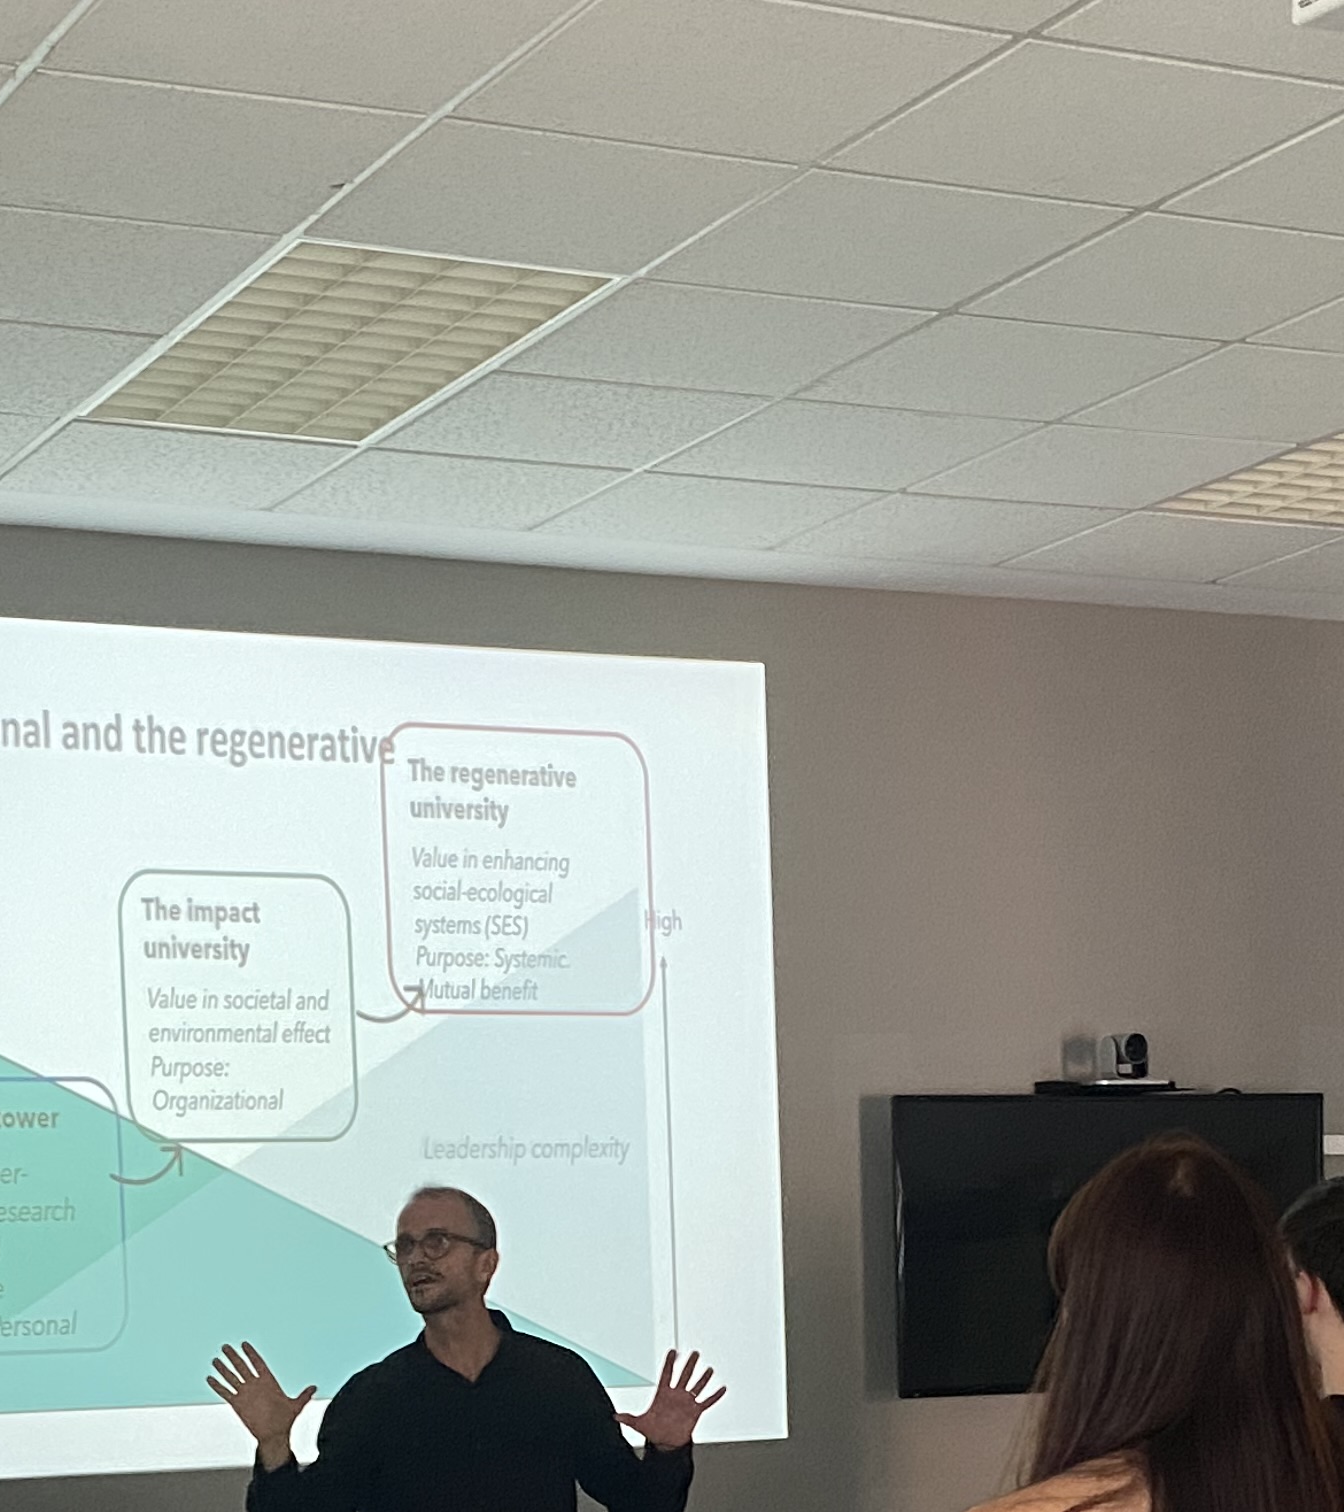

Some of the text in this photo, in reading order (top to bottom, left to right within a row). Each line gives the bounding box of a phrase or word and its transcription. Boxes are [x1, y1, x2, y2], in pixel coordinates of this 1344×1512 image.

[61, 713, 123, 752] and
[133, 715, 187, 755] the
[197, 723, 395, 767] regenerative
[407, 758, 577, 791] The regenerative
[410, 796, 509, 829] university
[412, 846, 570, 879] Value in enhancing
[413, 879, 553, 910] social-ecological
[141, 897, 261, 930] The impact
[414, 914, 529, 940] systems (SES)
[644, 908, 683, 937] High
[144, 934, 250, 967] university
[416, 945, 489, 973] Purpose:
[147, 987, 329, 1011] Value in societal and
[420, 977, 539, 1001] Mutual benefit
[148, 1020, 331, 1044] environmental effect
[151, 1056, 230, 1084] Purpose:
[152, 1088, 284, 1117] Organizational
[423, 1134, 630, 1165] Leadership complexity
